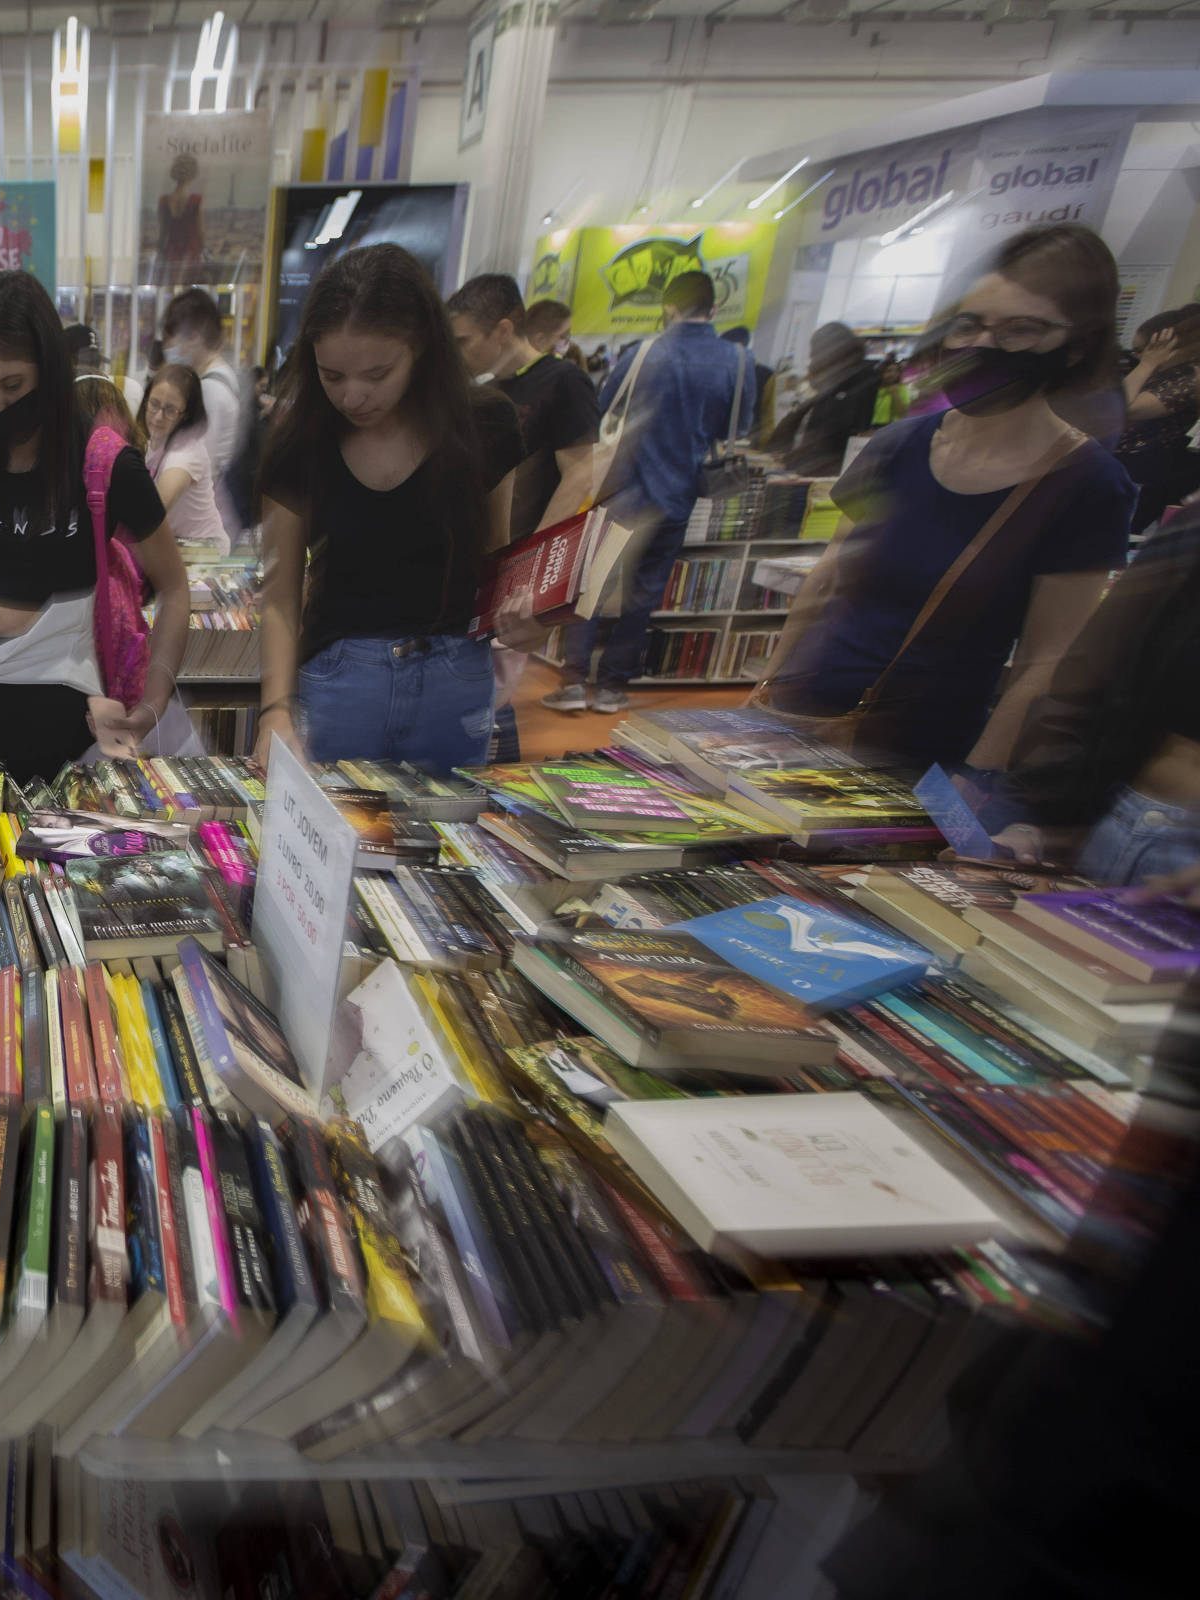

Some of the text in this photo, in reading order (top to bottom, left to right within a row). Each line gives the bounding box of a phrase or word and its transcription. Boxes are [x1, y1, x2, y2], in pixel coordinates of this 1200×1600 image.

[467, 48, 485, 121] A
[821, 150, 952, 229] global
[989, 157, 1099, 196] global
[981, 202, 1087, 229] gaudí
[539, 535, 562, 594] HUMANO
[549, 537, 568, 585] CORPO
[297, 813, 329, 867] JOVEM
[283, 840, 303, 880] LIVRO
[304, 873, 326, 916] 20,00
[297, 903, 320, 947] 50,00
[617, 953, 706, 967] RUPTURA
[377, 1063, 424, 1110] Pequeno
[422, 1053, 435, 1073] O
[100, 1157, 122, 1189] Jade
[101, 1197, 120, 1227] Trono
[287, 1237, 306, 1286] CATHERINE
[328, 1223, 351, 1278] INTERNATIONAL
